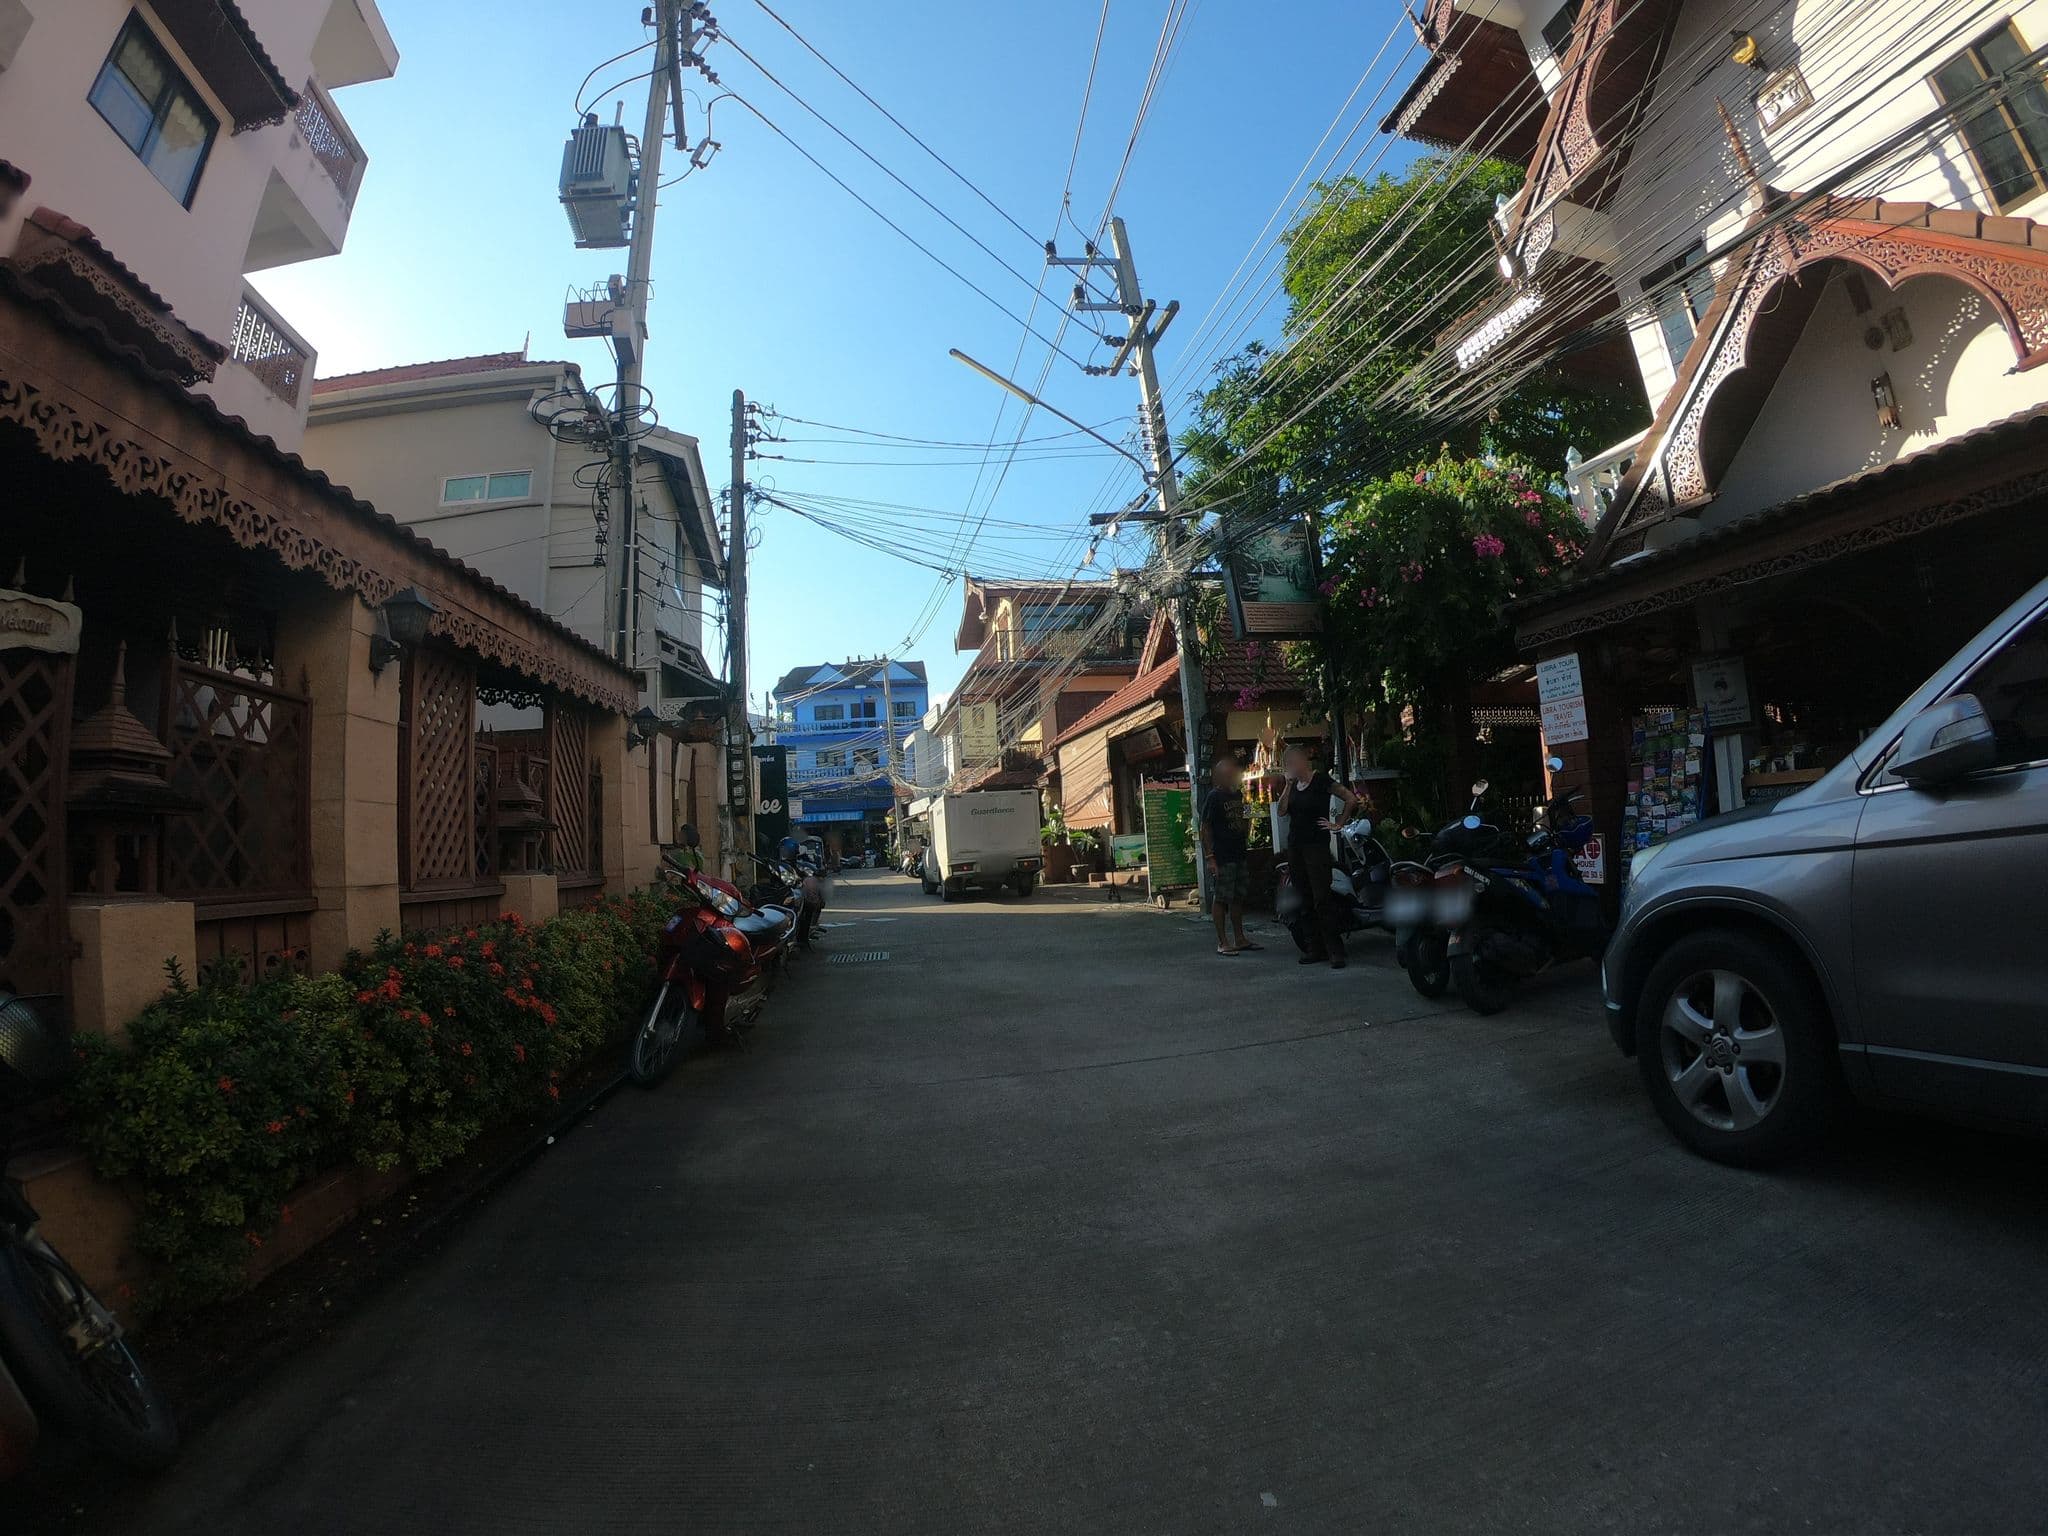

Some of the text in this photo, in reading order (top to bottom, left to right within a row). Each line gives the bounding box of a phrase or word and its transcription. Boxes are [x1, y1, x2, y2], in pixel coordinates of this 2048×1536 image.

[1541, 663, 1557, 672] LIBRA
[1559, 658, 1575, 668] TOUR
[1542, 705, 1558, 714] LIBRA
[1553, 711, 1574, 721] TRAVEL
